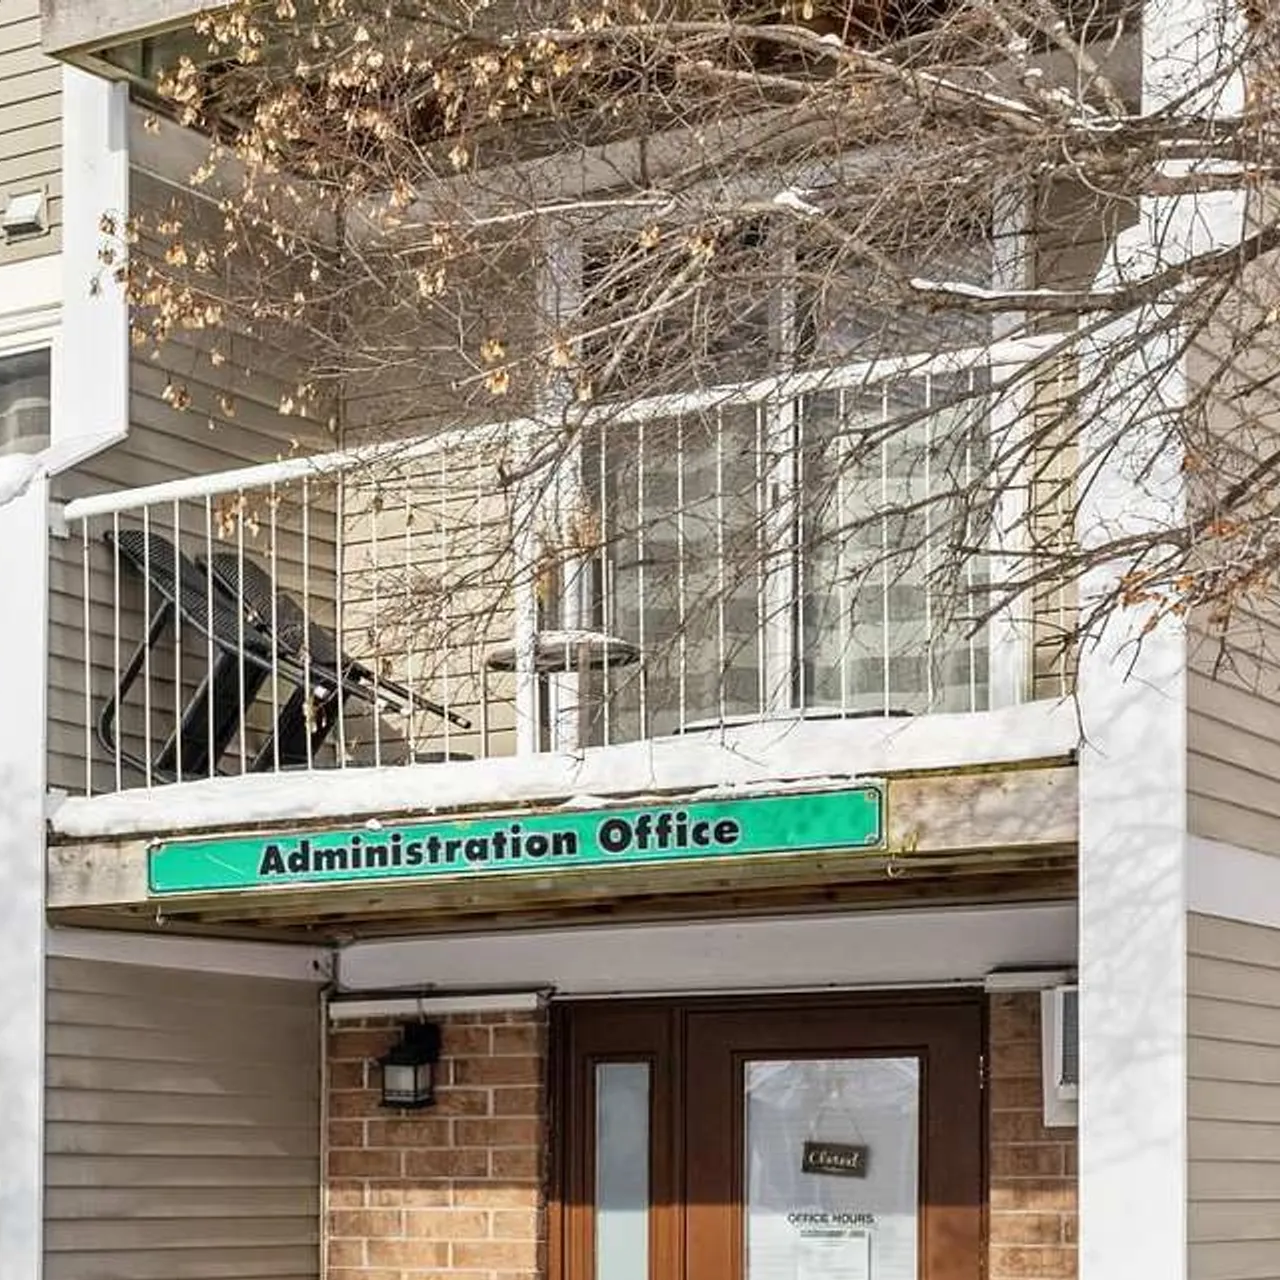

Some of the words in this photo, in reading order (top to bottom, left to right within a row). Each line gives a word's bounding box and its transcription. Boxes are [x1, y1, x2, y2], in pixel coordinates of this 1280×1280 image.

[259, 824, 577, 877] Administration
[598, 812, 740, 854] Office
[787, 1212, 829, 1224] OFFICE
[832, 1212, 875, 1225] HOURS
